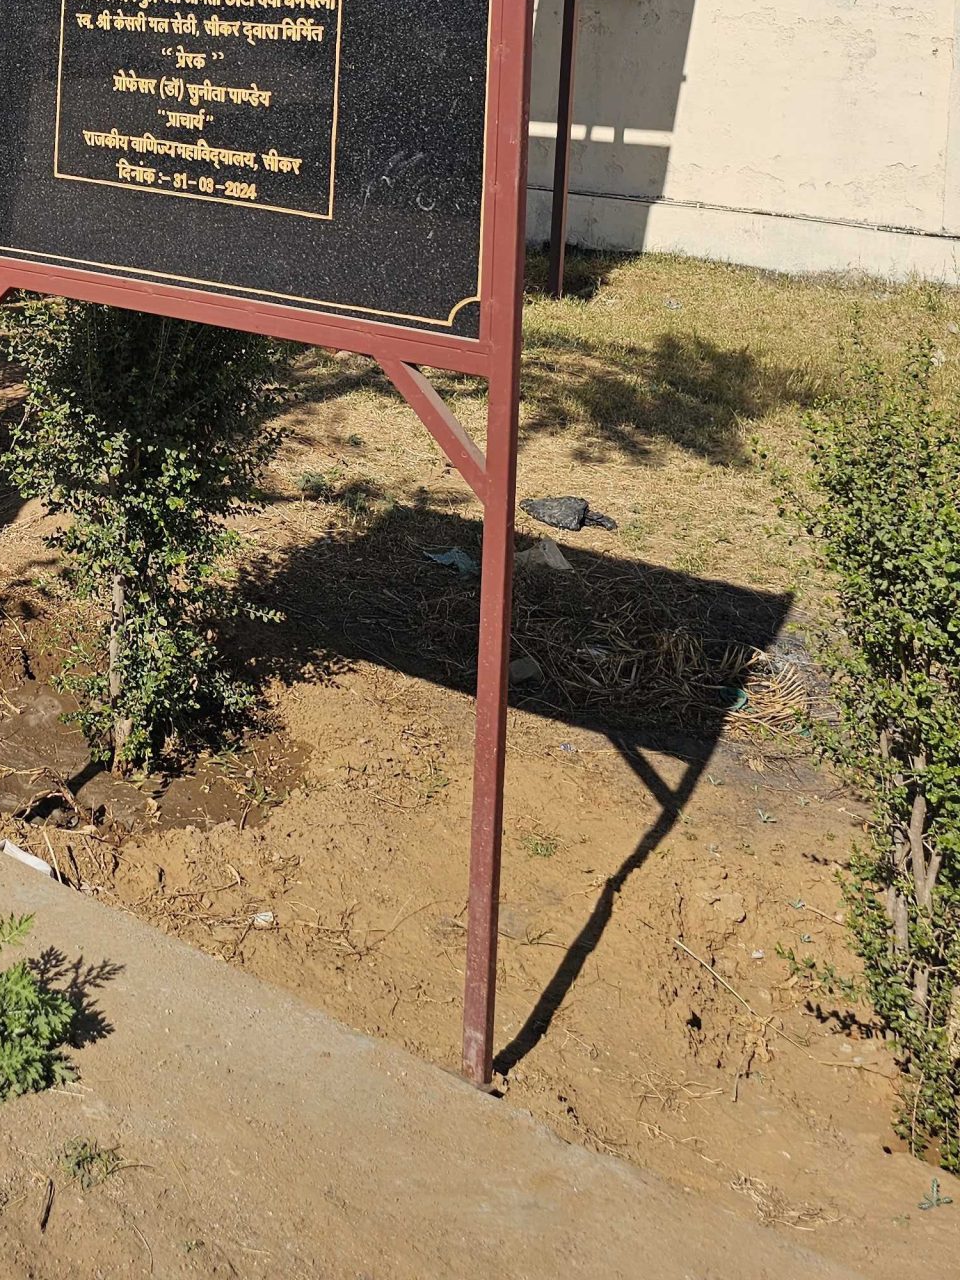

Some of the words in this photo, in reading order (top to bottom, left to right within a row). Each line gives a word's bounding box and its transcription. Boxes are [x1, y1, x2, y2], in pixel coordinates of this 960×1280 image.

[96, 10, 112, 29] श्री
[113, 9, 146, 32] केसरी
[204, 14, 239, 37] सीकर
[282, 17, 324, 41] निर्मित
[113, 70, 157, 95] प्रोफेसर
[187, 80, 226, 105] सुनीता
[228, 83, 271, 107] पाण्डेय
[83, 128, 128, 151] राजकीय
[262, 149, 302, 175] सीकर
[117, 158, 156, 183] दिनांक
